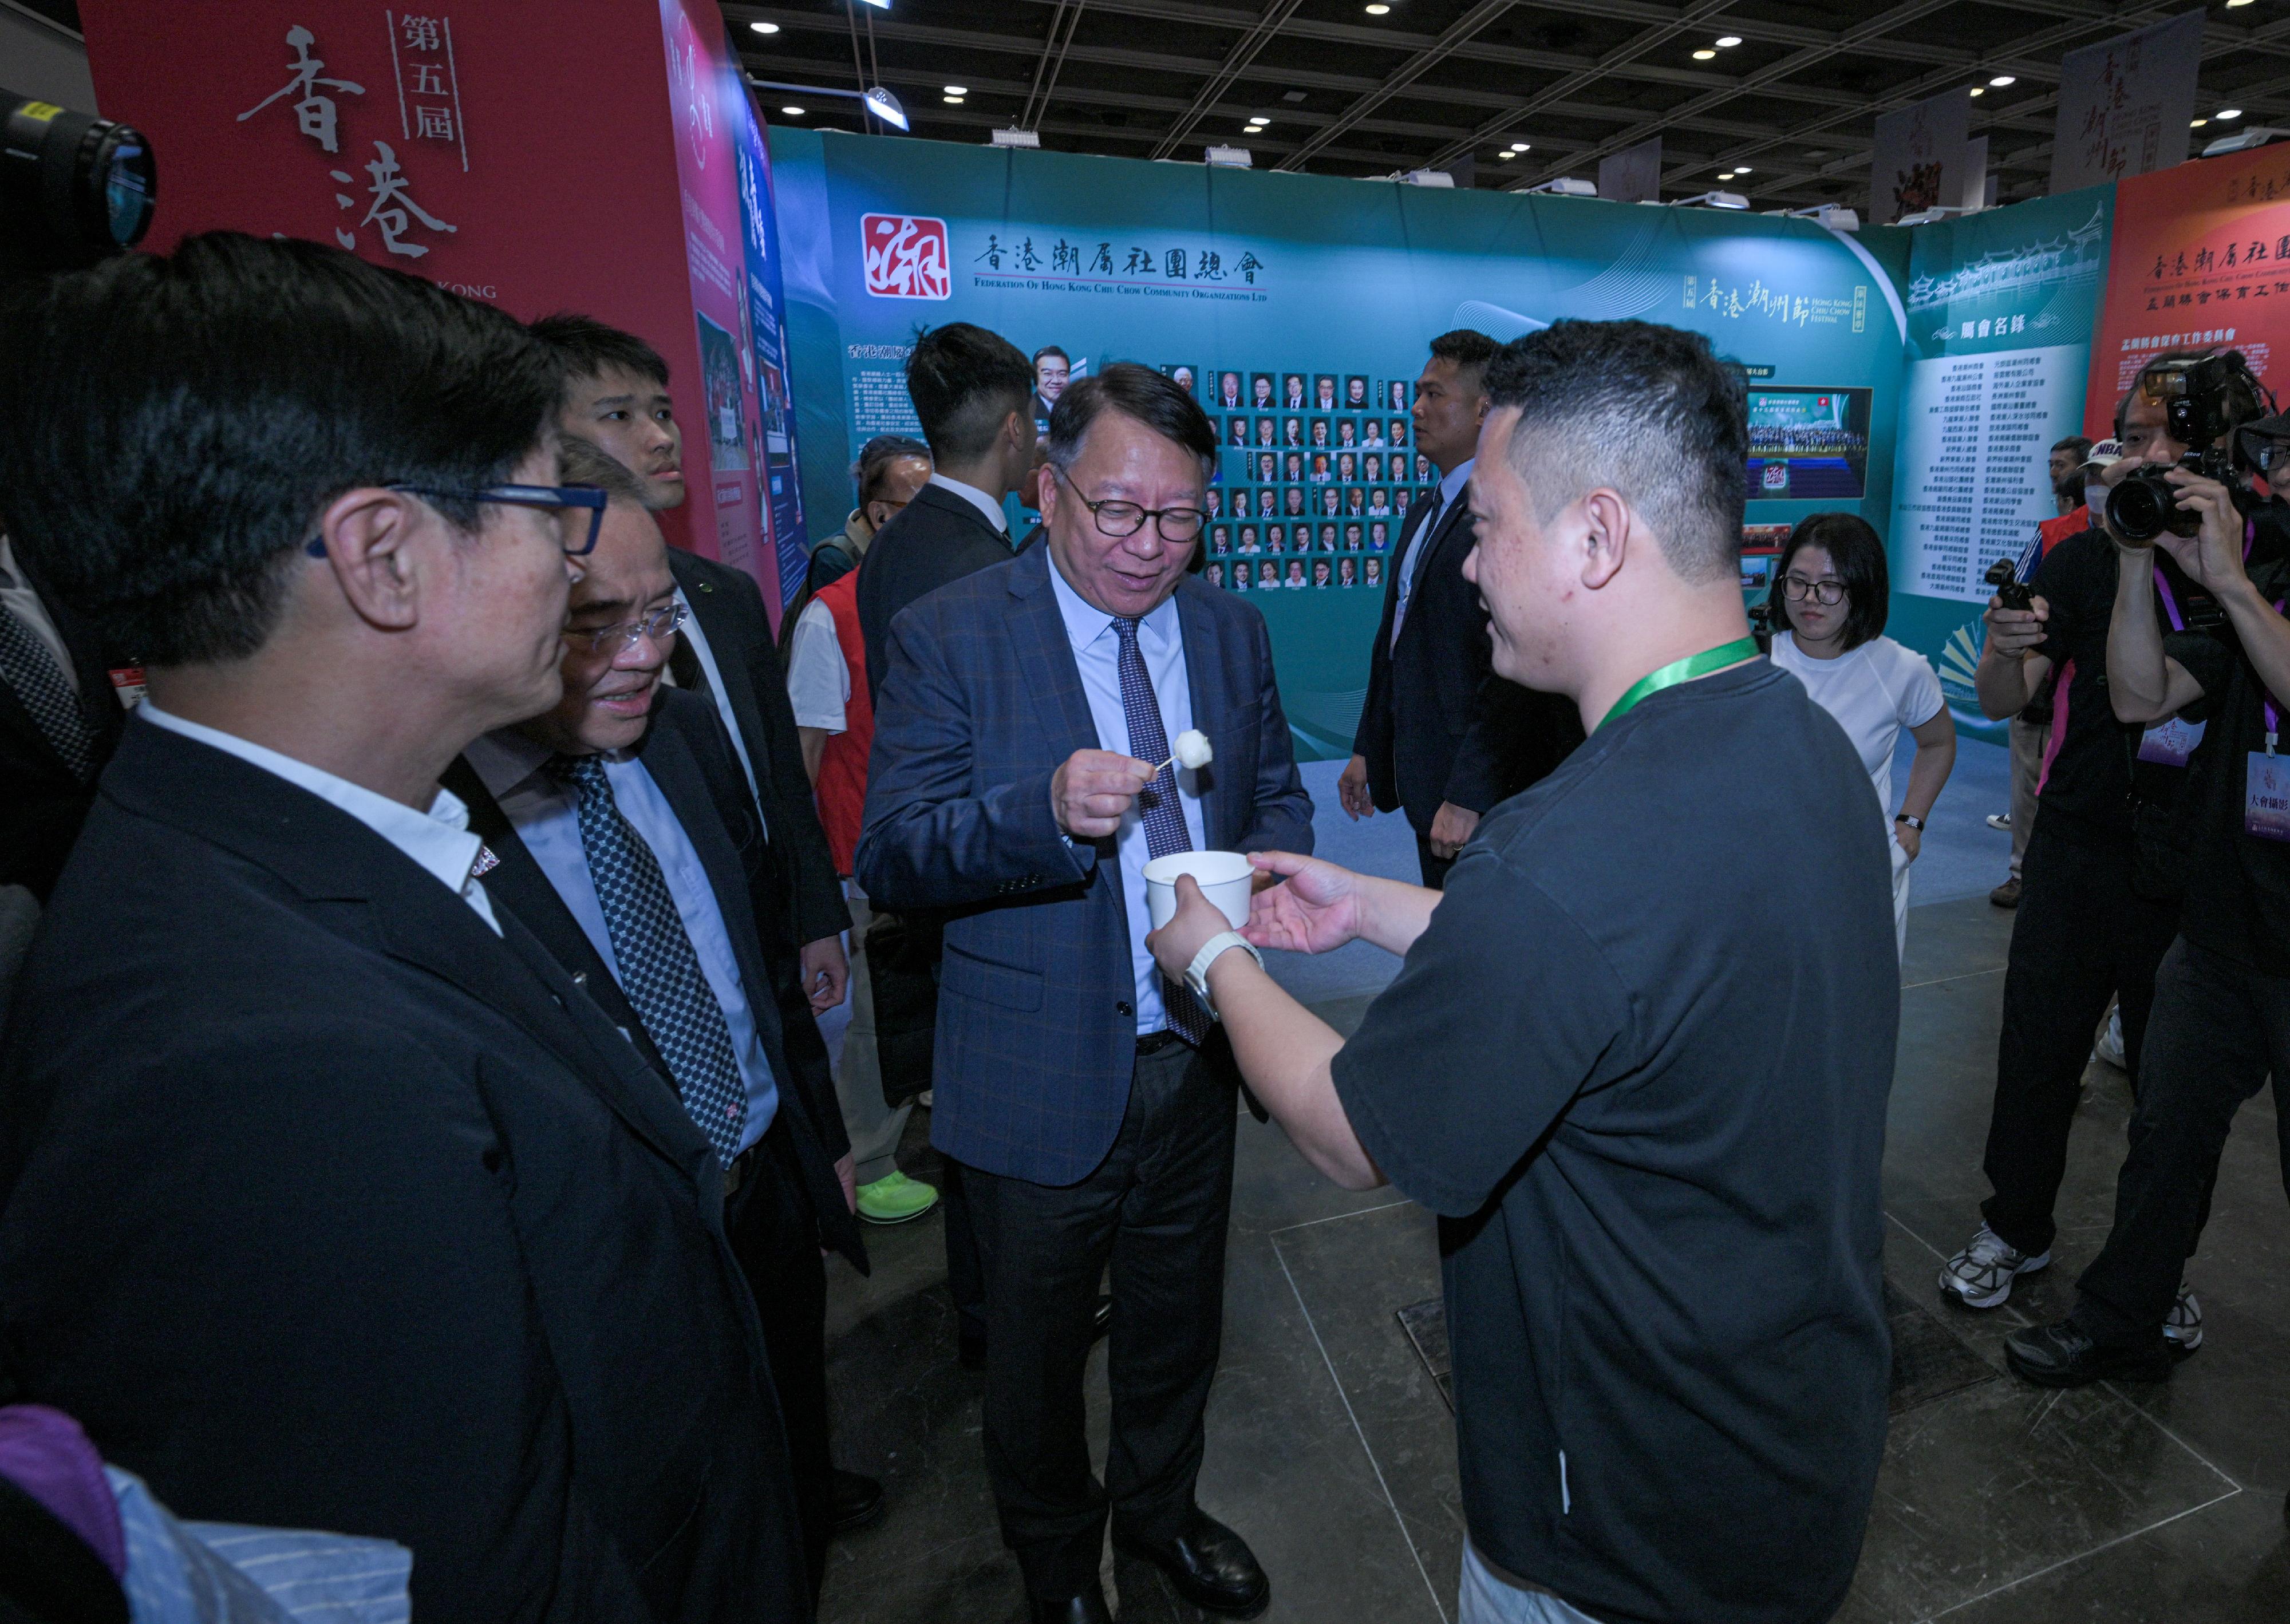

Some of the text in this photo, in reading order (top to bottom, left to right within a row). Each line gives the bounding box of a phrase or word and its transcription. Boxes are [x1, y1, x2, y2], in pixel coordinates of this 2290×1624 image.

[401, 13, 454, 141] 第五屆
[974, 277, 1024, 289] FEDERATION
[1041, 280, 1065, 291] HONG
[1068, 282, 1092, 293] KONG
[1094, 283, 1114, 293] CHIU
[1117, 285, 1141, 295] CHOW
[1144, 286, 1189, 298] COMMUNITY
[1192, 289, 1250, 301] ORGANIZATIONS
[1252, 293, 1268, 302] LTD
[2250, 793, 2288, 811] 大會攝影
